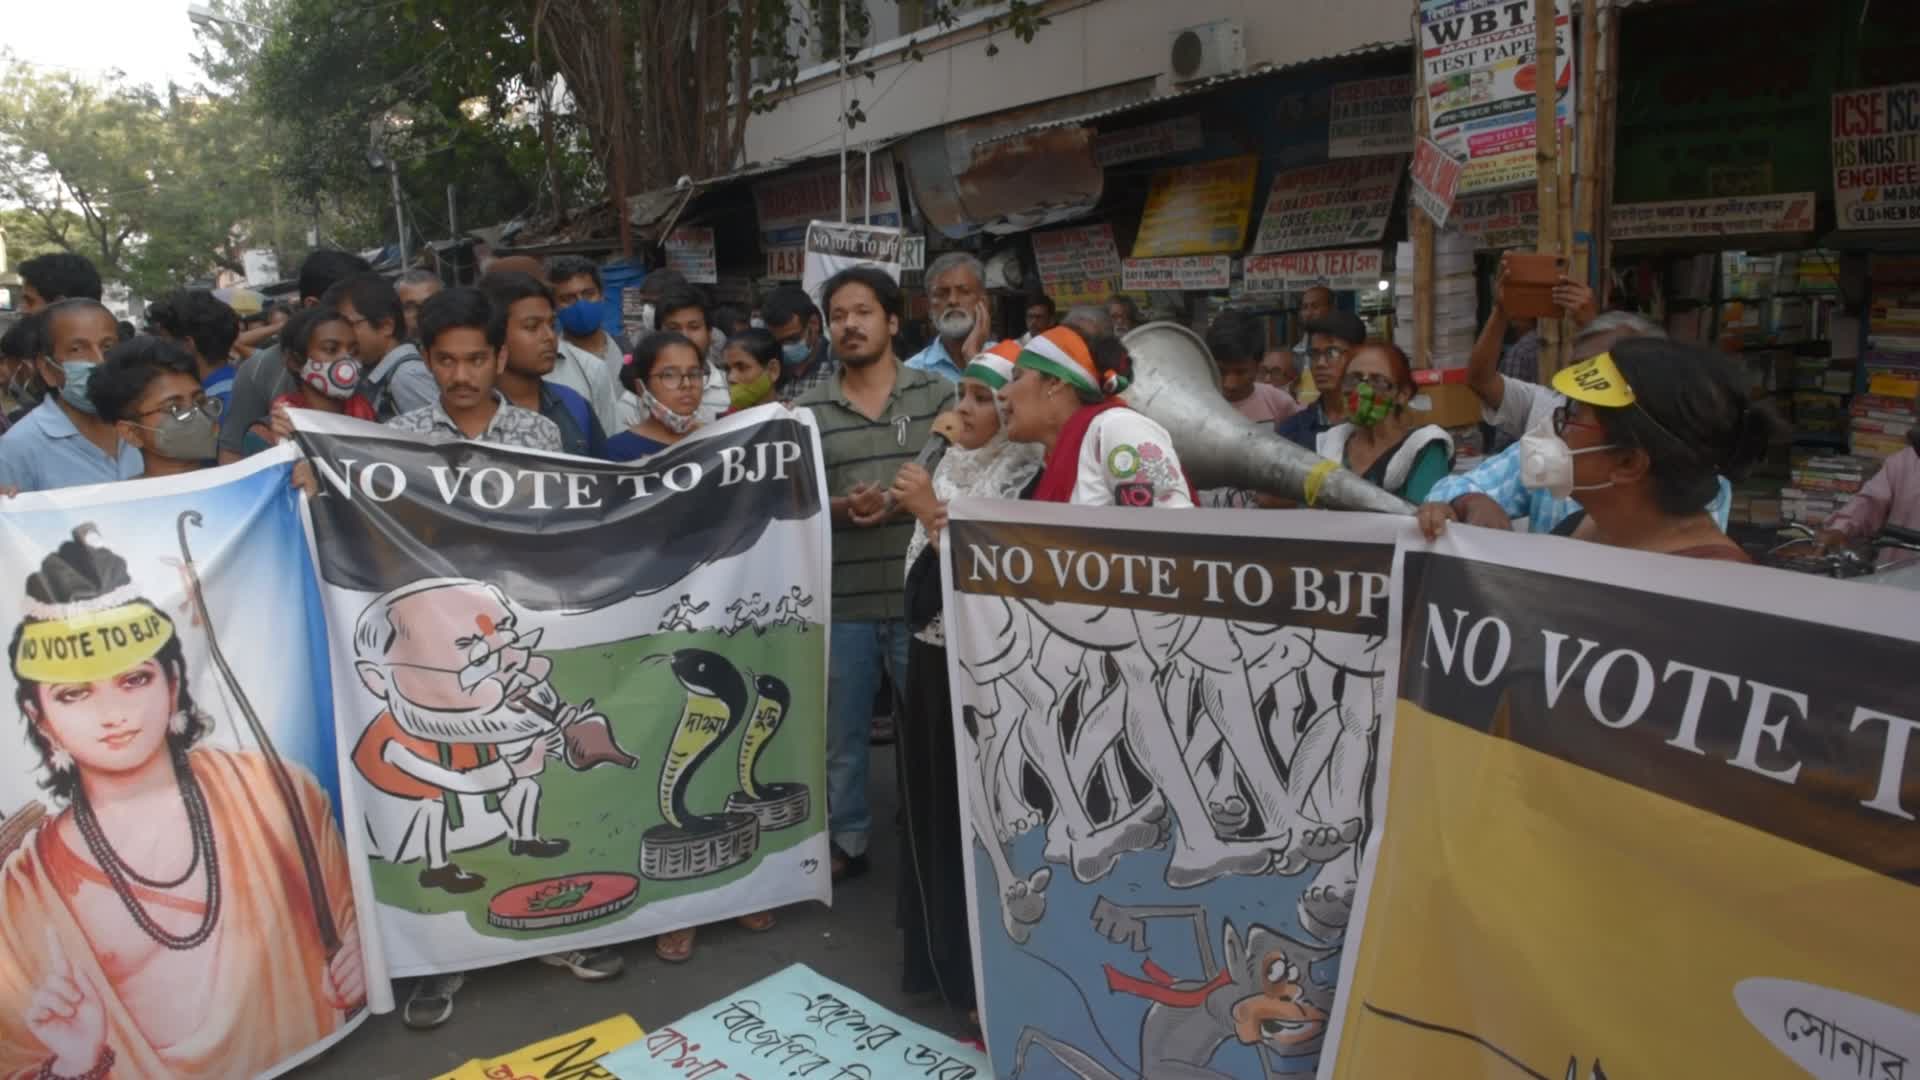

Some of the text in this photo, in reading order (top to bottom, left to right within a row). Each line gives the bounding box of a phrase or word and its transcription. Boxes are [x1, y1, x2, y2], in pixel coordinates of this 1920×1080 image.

[1430, 30, 1564, 75] TEST PAPES
[1441, 24, 1537, 55] MADHYAMI
[1834, 94, 1883, 137] ICSE
[1833, 140, 1856, 167] HS
[1858, 137, 1895, 165] NIOS
[1574, 367, 1611, 391] BJP
[313, 440, 801, 510] NO VOTE TO BJP
[968, 543, 1390, 619] NO VOTE TO BJP
[41, 632, 95, 661] VOTE
[97, 626, 127, 652] TO
[130, 615, 161, 644] BJP
[1421, 602, 1512, 687] NO
[1540, 629, 1809, 785] VOTE
[711, 999, 831, 1078] বিজেপির
